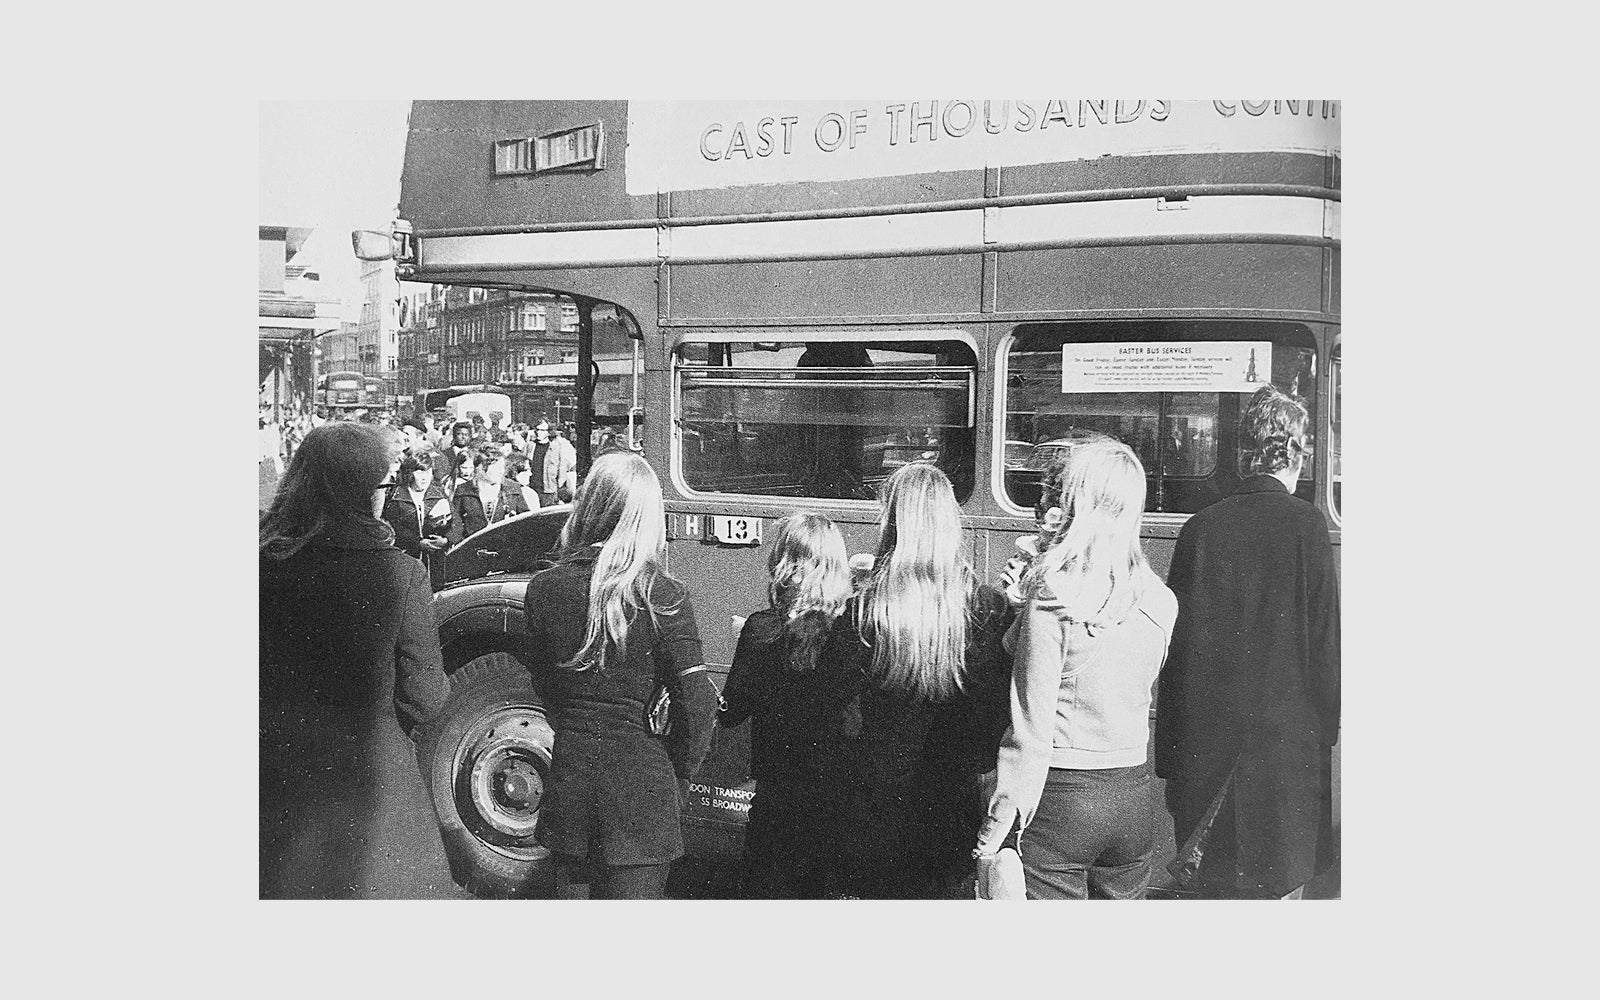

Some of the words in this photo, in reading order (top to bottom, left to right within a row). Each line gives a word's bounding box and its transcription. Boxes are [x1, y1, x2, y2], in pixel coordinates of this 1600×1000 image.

[700, 116, 798, 161] CAST
[815, 109, 867, 152] OF
[886, 99, 1172, 145] THOUSANDS
[685, 514, 698, 535] H
[727, 519, 748, 539] 13
[689, 783, 711, 794] DON
[714, 786, 756, 801] TRANSPO
[713, 799, 753, 812] BROADW
